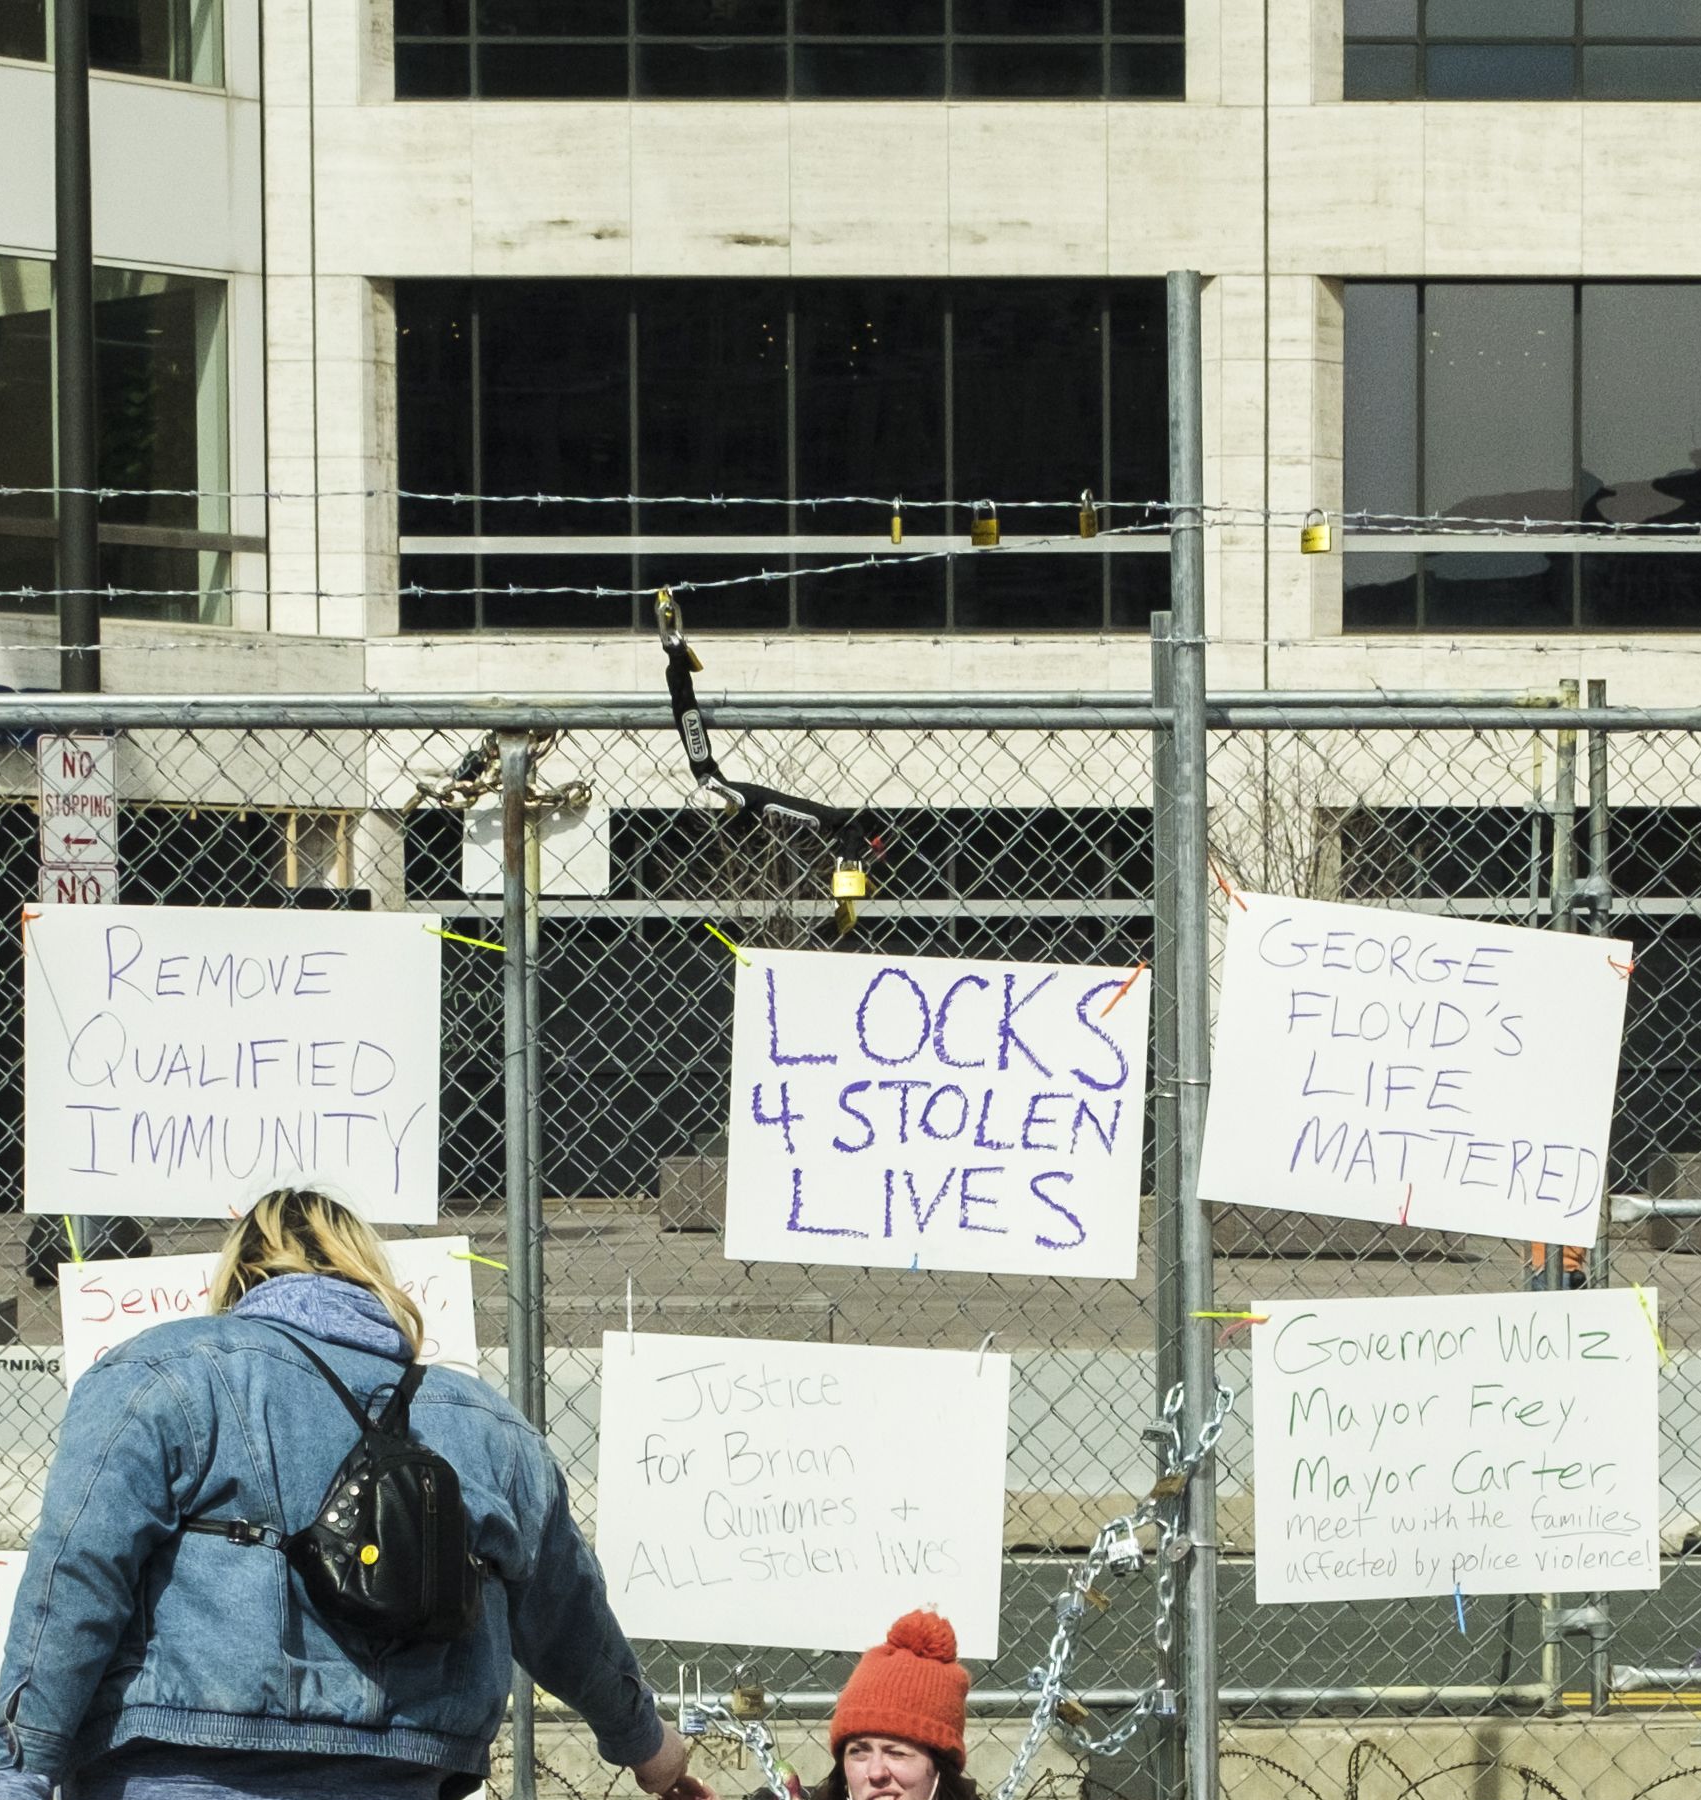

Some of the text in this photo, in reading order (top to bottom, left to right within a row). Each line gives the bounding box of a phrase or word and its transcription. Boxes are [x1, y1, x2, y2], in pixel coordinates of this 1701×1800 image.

[63, 751, 95, 779] NO
[45, 794, 111, 817] STOPPING
[57, 875, 101, 904] NO
[106, 924, 348, 1007] REMOVE
[1259, 918, 1513, 987] GEORGE
[67, 1010, 396, 1096] QUALIFIED
[766, 967, 1130, 1091] LOCKS
[1287, 989, 1524, 1057] FLOYD'S
[1302, 1050, 1473, 1114] LIFE
[65, 1103, 427, 1194] IMMUNITY
[752, 1080, 1122, 1157] 4 STOLEN
[1290, 1115, 1601, 1219] MATTERED
[786, 1166, 1087, 1250] LIVES
[1273, 1312, 1476, 1375] Governor
[656, 1362, 843, 1423] Justice
[1289, 1387, 1439, 1453] Mayor
[636, 1430, 855, 1486] for Brian
[1292, 1455, 1426, 1513] Mayor
[1285, 1494, 1642, 1543] meet with the families
[624, 1540, 733, 1594] ALL
[1286, 1539, 1654, 1589] affected by police violence!
